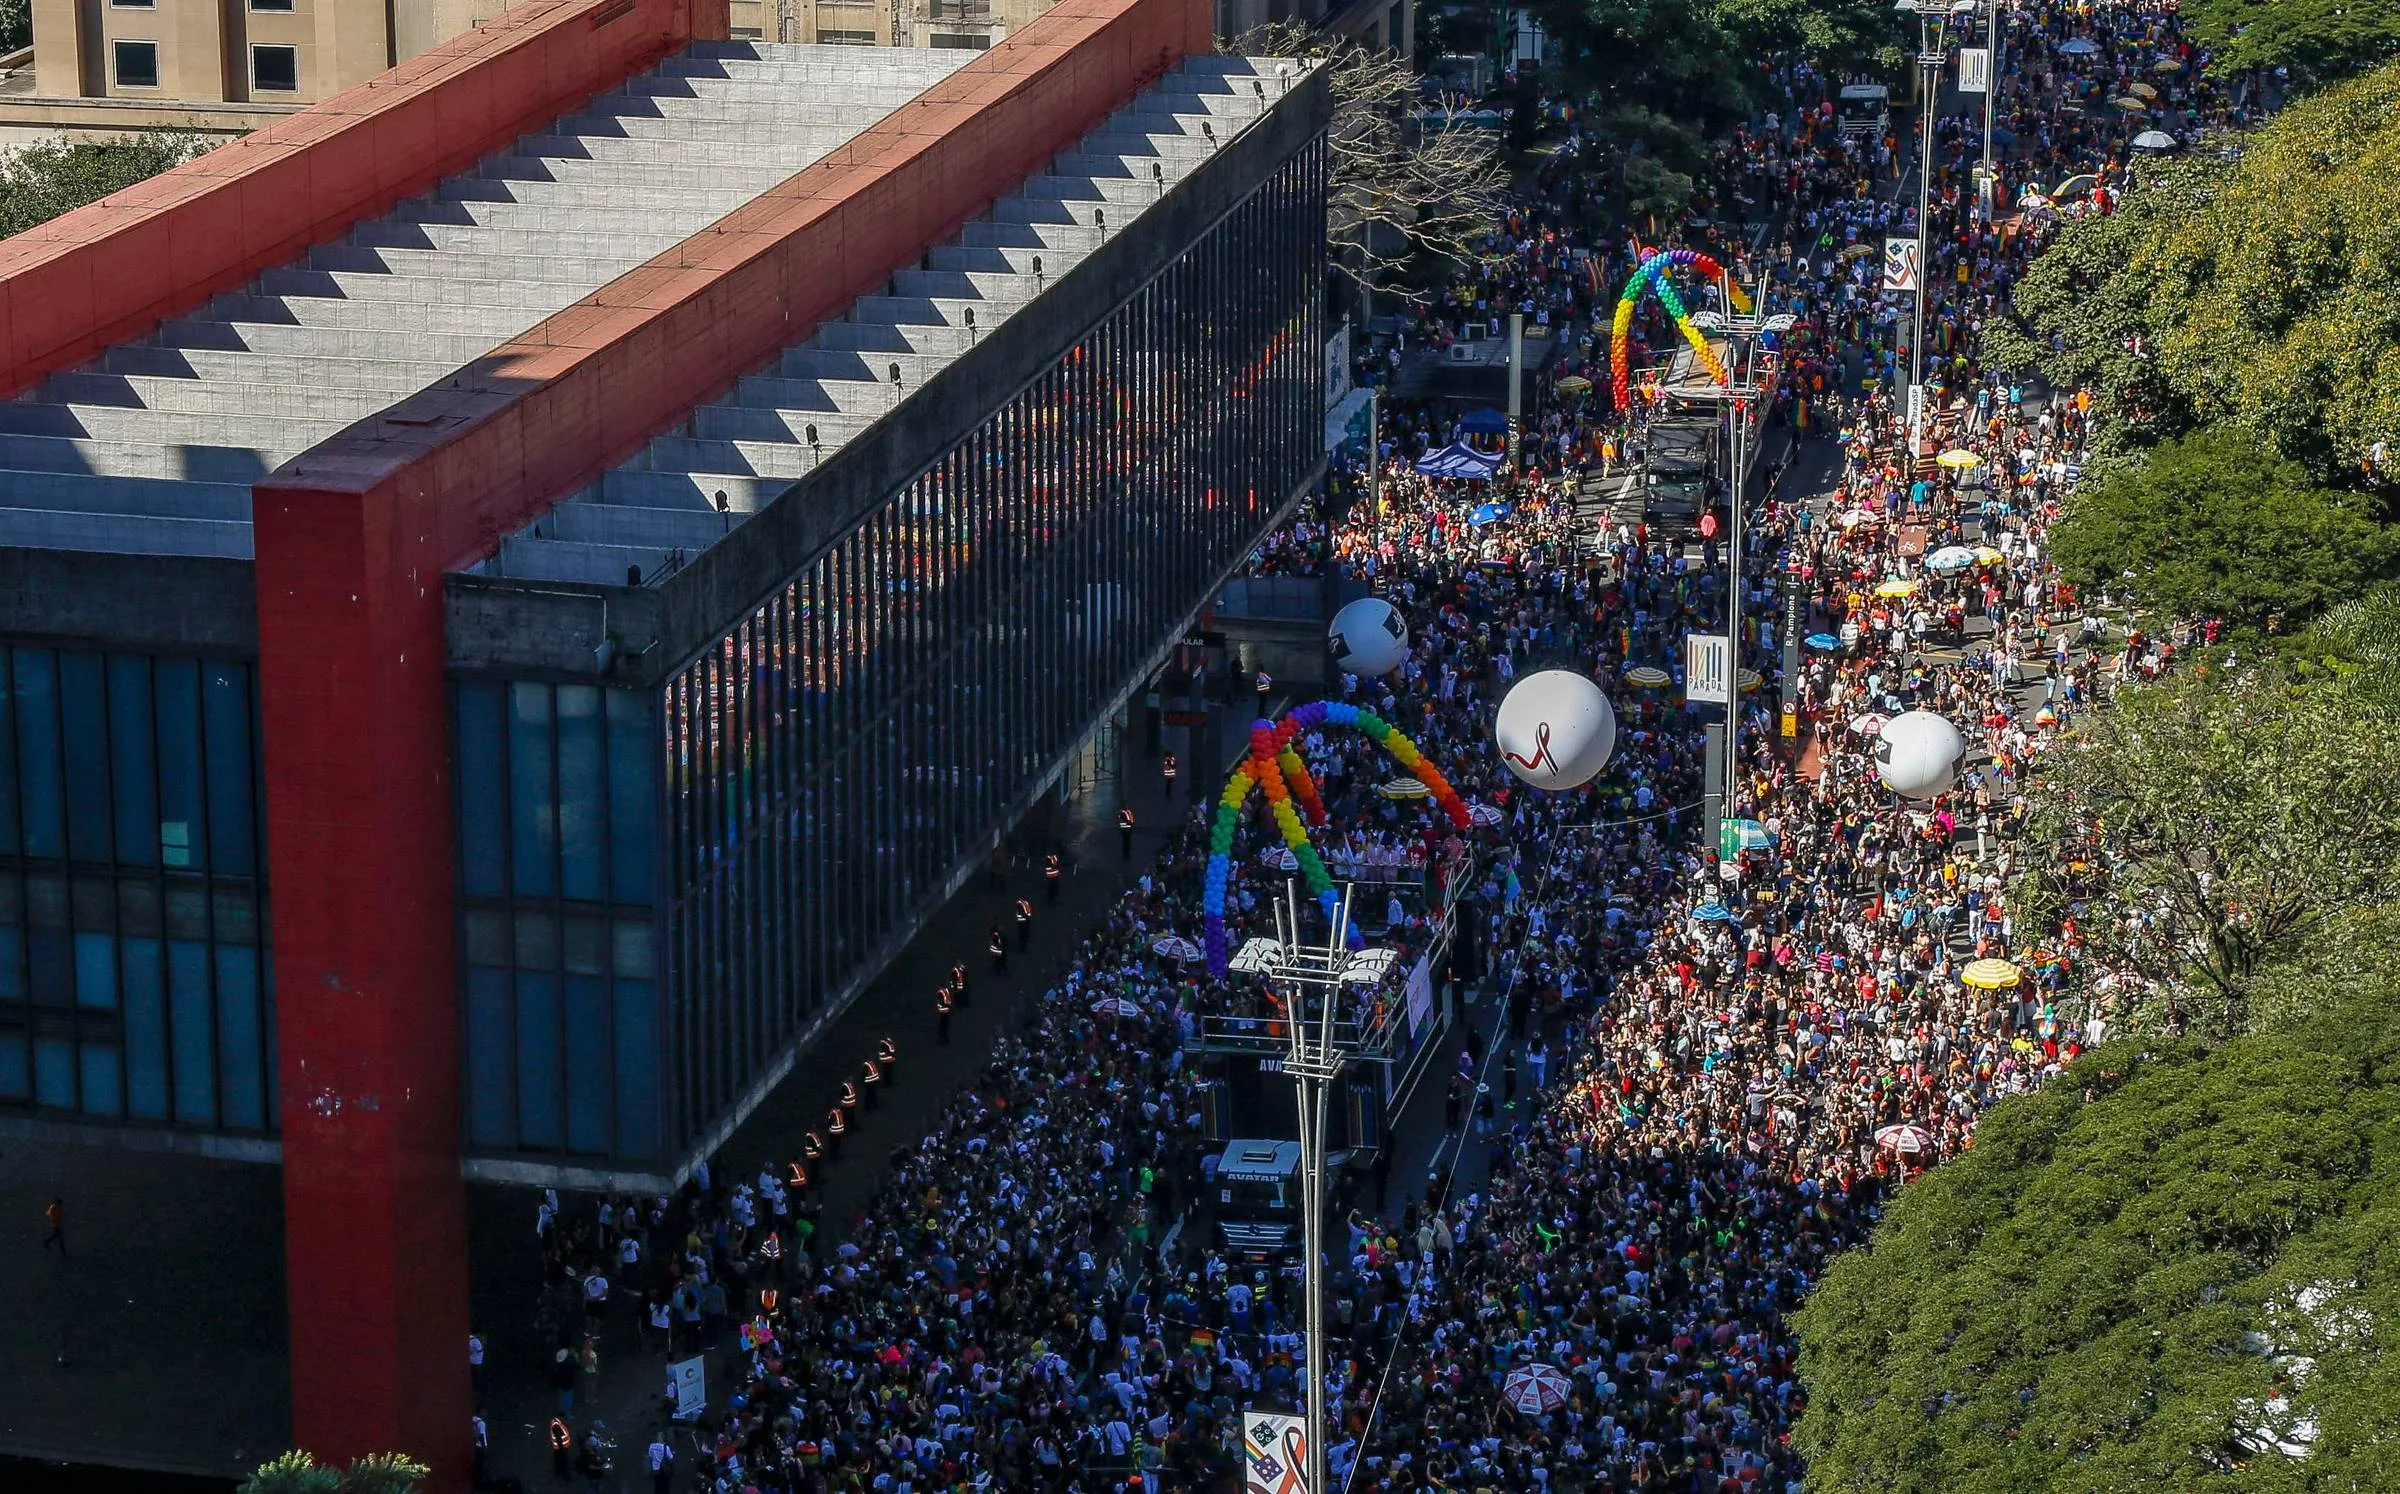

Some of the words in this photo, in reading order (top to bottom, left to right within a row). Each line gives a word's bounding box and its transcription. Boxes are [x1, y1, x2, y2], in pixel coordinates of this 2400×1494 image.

[1786, 594, 1796, 638] Pamplona
[1785, 638, 1794, 647] R.
[1688, 677, 1722, 693] PARADA
[1259, 1059, 1283, 1071] AVA
[1227, 1173, 1279, 1182] AVATAR
